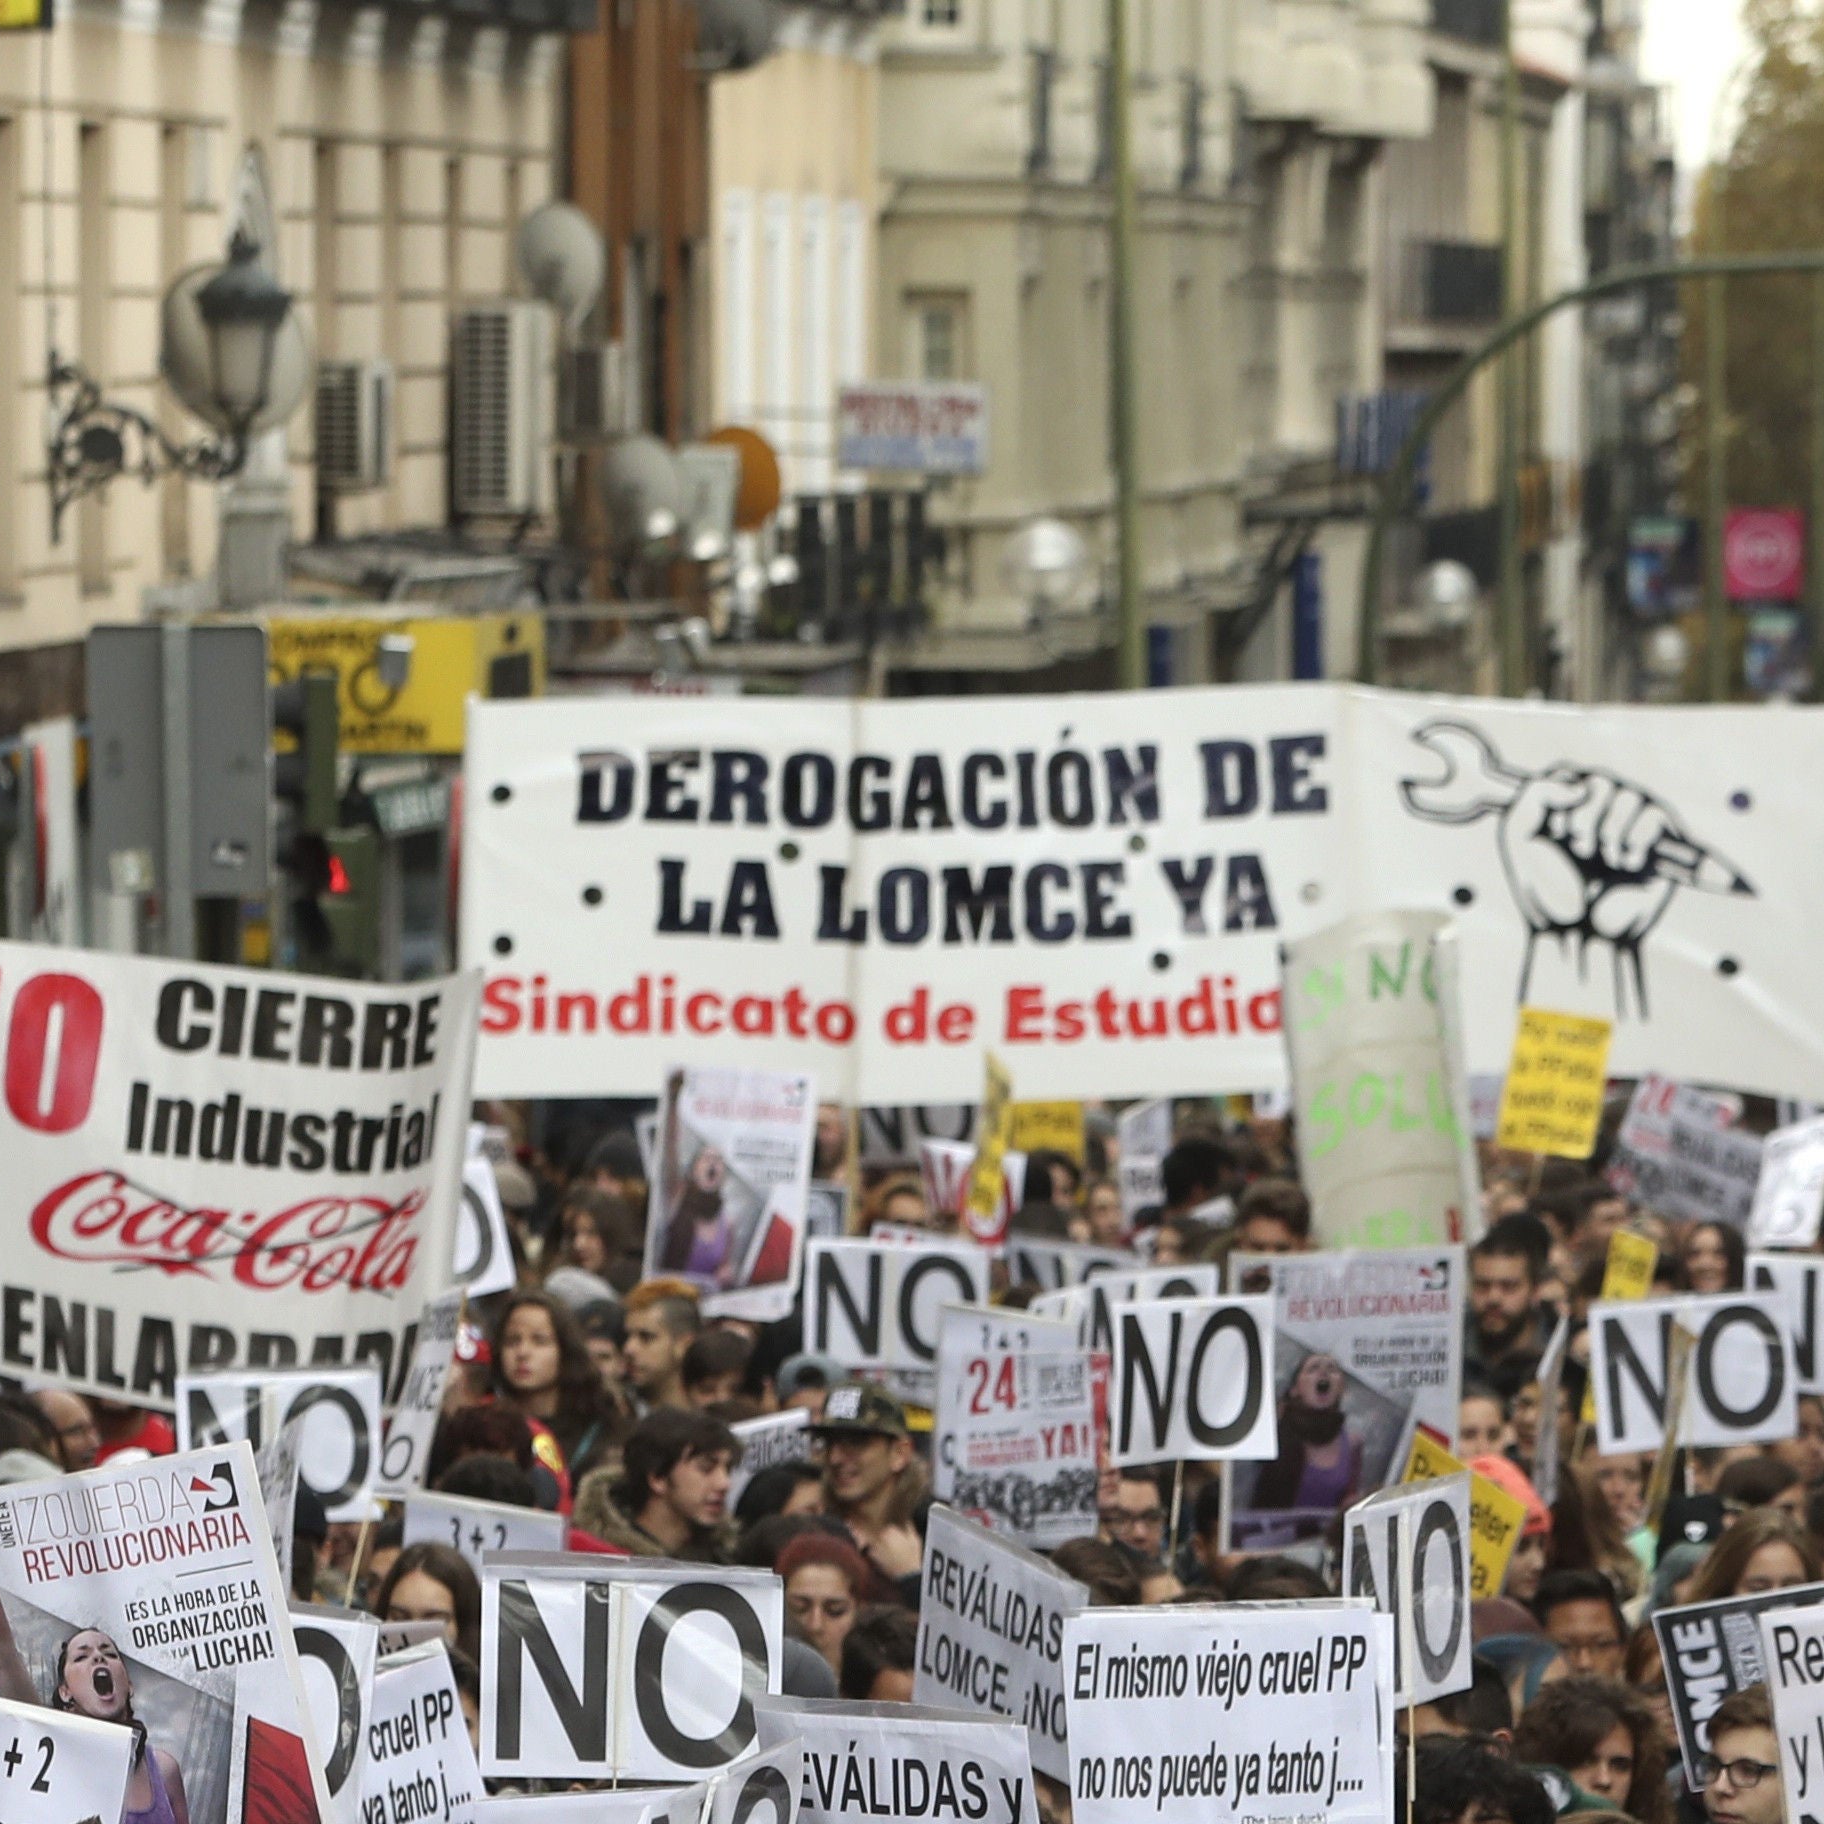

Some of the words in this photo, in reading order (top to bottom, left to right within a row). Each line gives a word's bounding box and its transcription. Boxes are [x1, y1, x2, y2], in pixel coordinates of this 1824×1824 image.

[577, 727, 1159, 832] DEROGACIÓN
[1199, 735, 1326, 818] DE
[657, 858, 777, 939] LA
[818, 862, 1131, 943] LOMCE
[1163, 853, 1278, 934] YA
[155, 977, 440, 1072] CIERRE
[481, 975, 857, 1045] Sindicato
[885, 986, 976, 1043] de
[126, 1081, 440, 1175] Industrial
[967, 1355, 1018, 1416] 24
[1120, 1305, 1263, 1454] NO
[1603, 1305, 1776, 1442] NO
[1041, 1424, 1090, 1461] YA!
[14, 1470, 194, 1547] IZQUIERDA
[22, 1511, 251, 1584] REVOLUCIONARIA
[125, 1600, 150, 1624] ¡ES
[152, 1596, 172, 1618] LA
[174, 1588, 215, 1614] HORA
[217, 1584, 239, 1606] DE
[241, 1579, 261, 1602] LA
[131, 1601, 268, 1650] ORGANIZACIÓN
[496, 1580, 770, 1769] NO
[1074, 1642, 1100, 1700] El
[1106, 1640, 1188, 1695] mismo
[1194, 1638, 1253, 1711] viejo
[1257, 1636, 1319, 1694] cruel
[1327, 1634, 1367, 1692] PP
[1077, 1759, 1106, 1799] no
[1111, 1757, 1153, 1797] nos
[1157, 1740, 1227, 1812] puede
[1233, 1750, 1260, 1809] ya
[1266, 1737, 1325, 1794] tanto
[1325, 1737, 1364, 1805] j....
